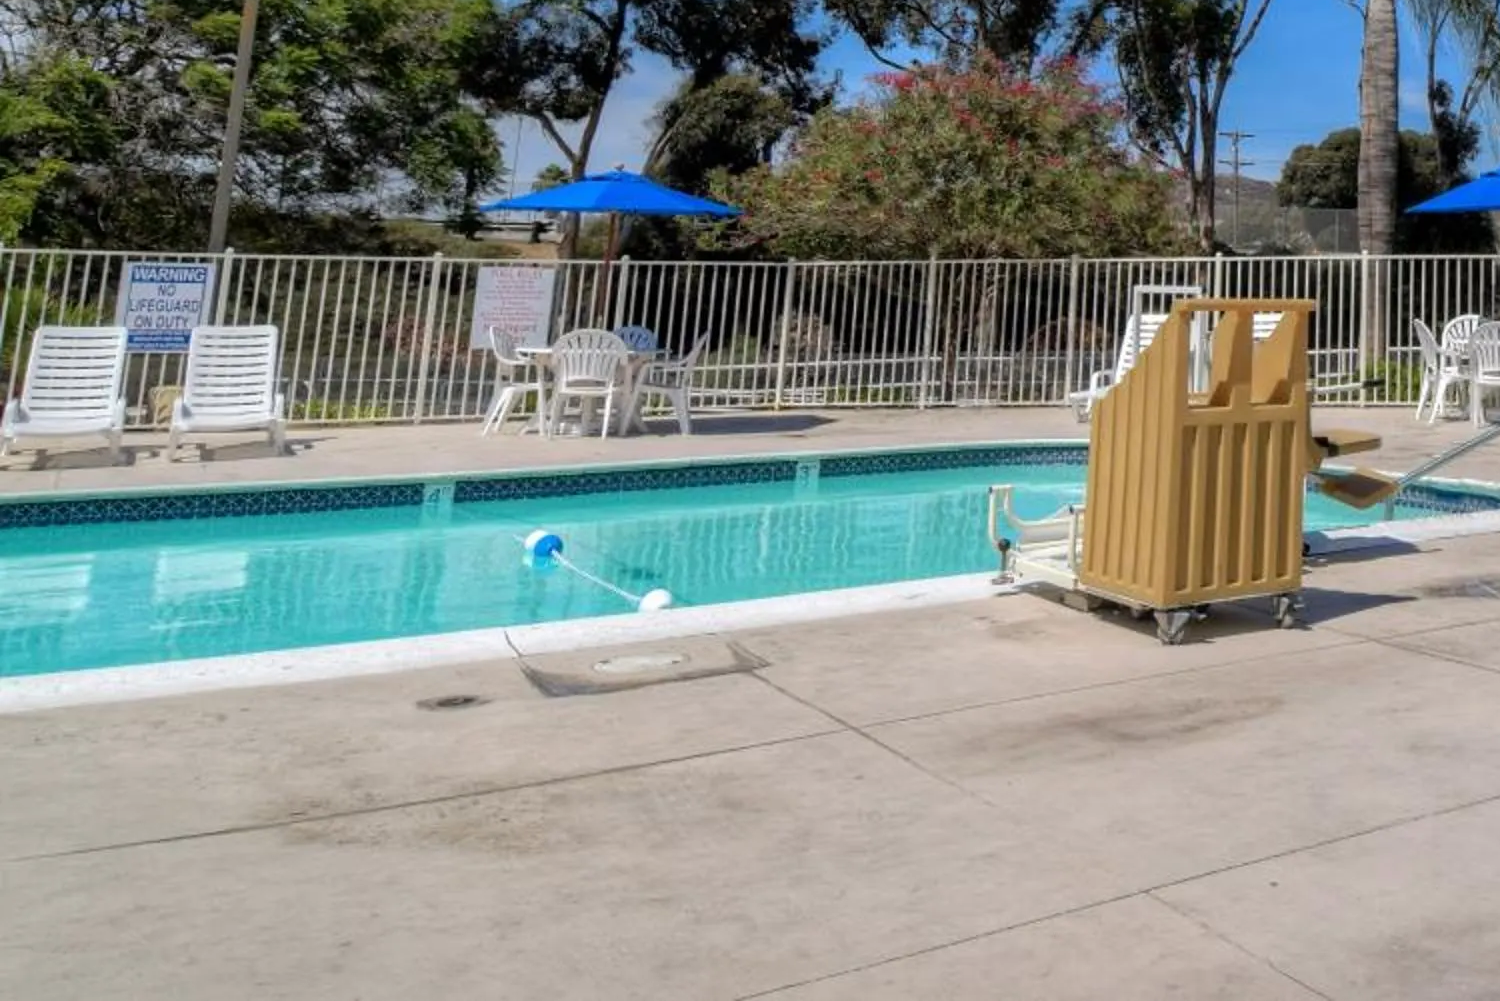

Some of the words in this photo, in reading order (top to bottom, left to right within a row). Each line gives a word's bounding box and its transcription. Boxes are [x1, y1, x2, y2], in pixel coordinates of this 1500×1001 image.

[133, 267, 206, 282] WARNING
[157, 284, 177, 297] NO
[129, 299, 201, 312] LIFEGUARD
[134, 315, 153, 328] ON
[155, 315, 189, 328] DUTY
